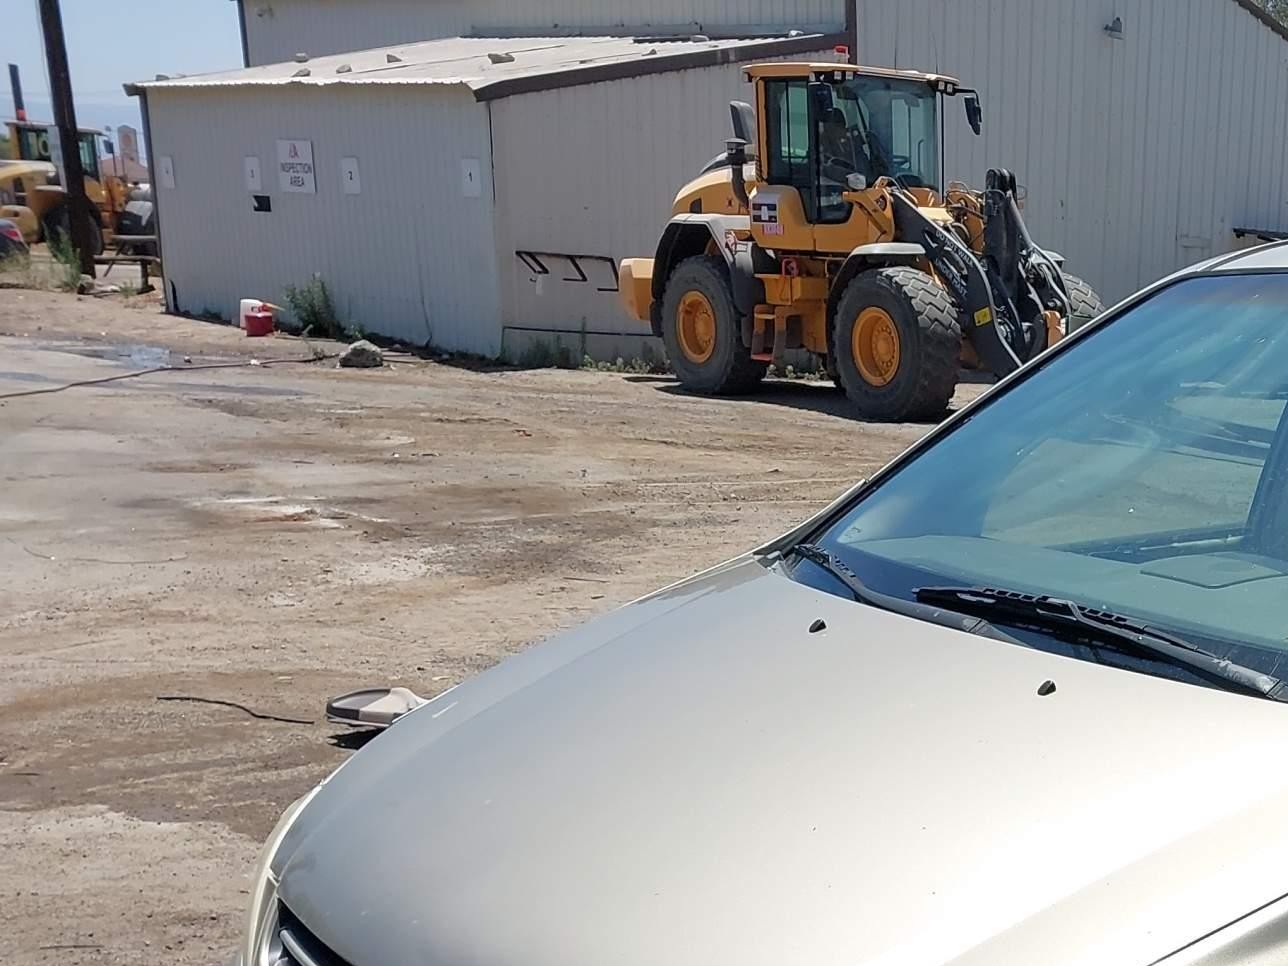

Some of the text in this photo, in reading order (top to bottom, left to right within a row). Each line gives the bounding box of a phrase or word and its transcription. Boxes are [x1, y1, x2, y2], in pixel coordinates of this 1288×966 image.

[280, 162, 313, 174] INSPECTION
[290, 175, 305, 187] AREA
[945, 238, 959, 253] NOT
